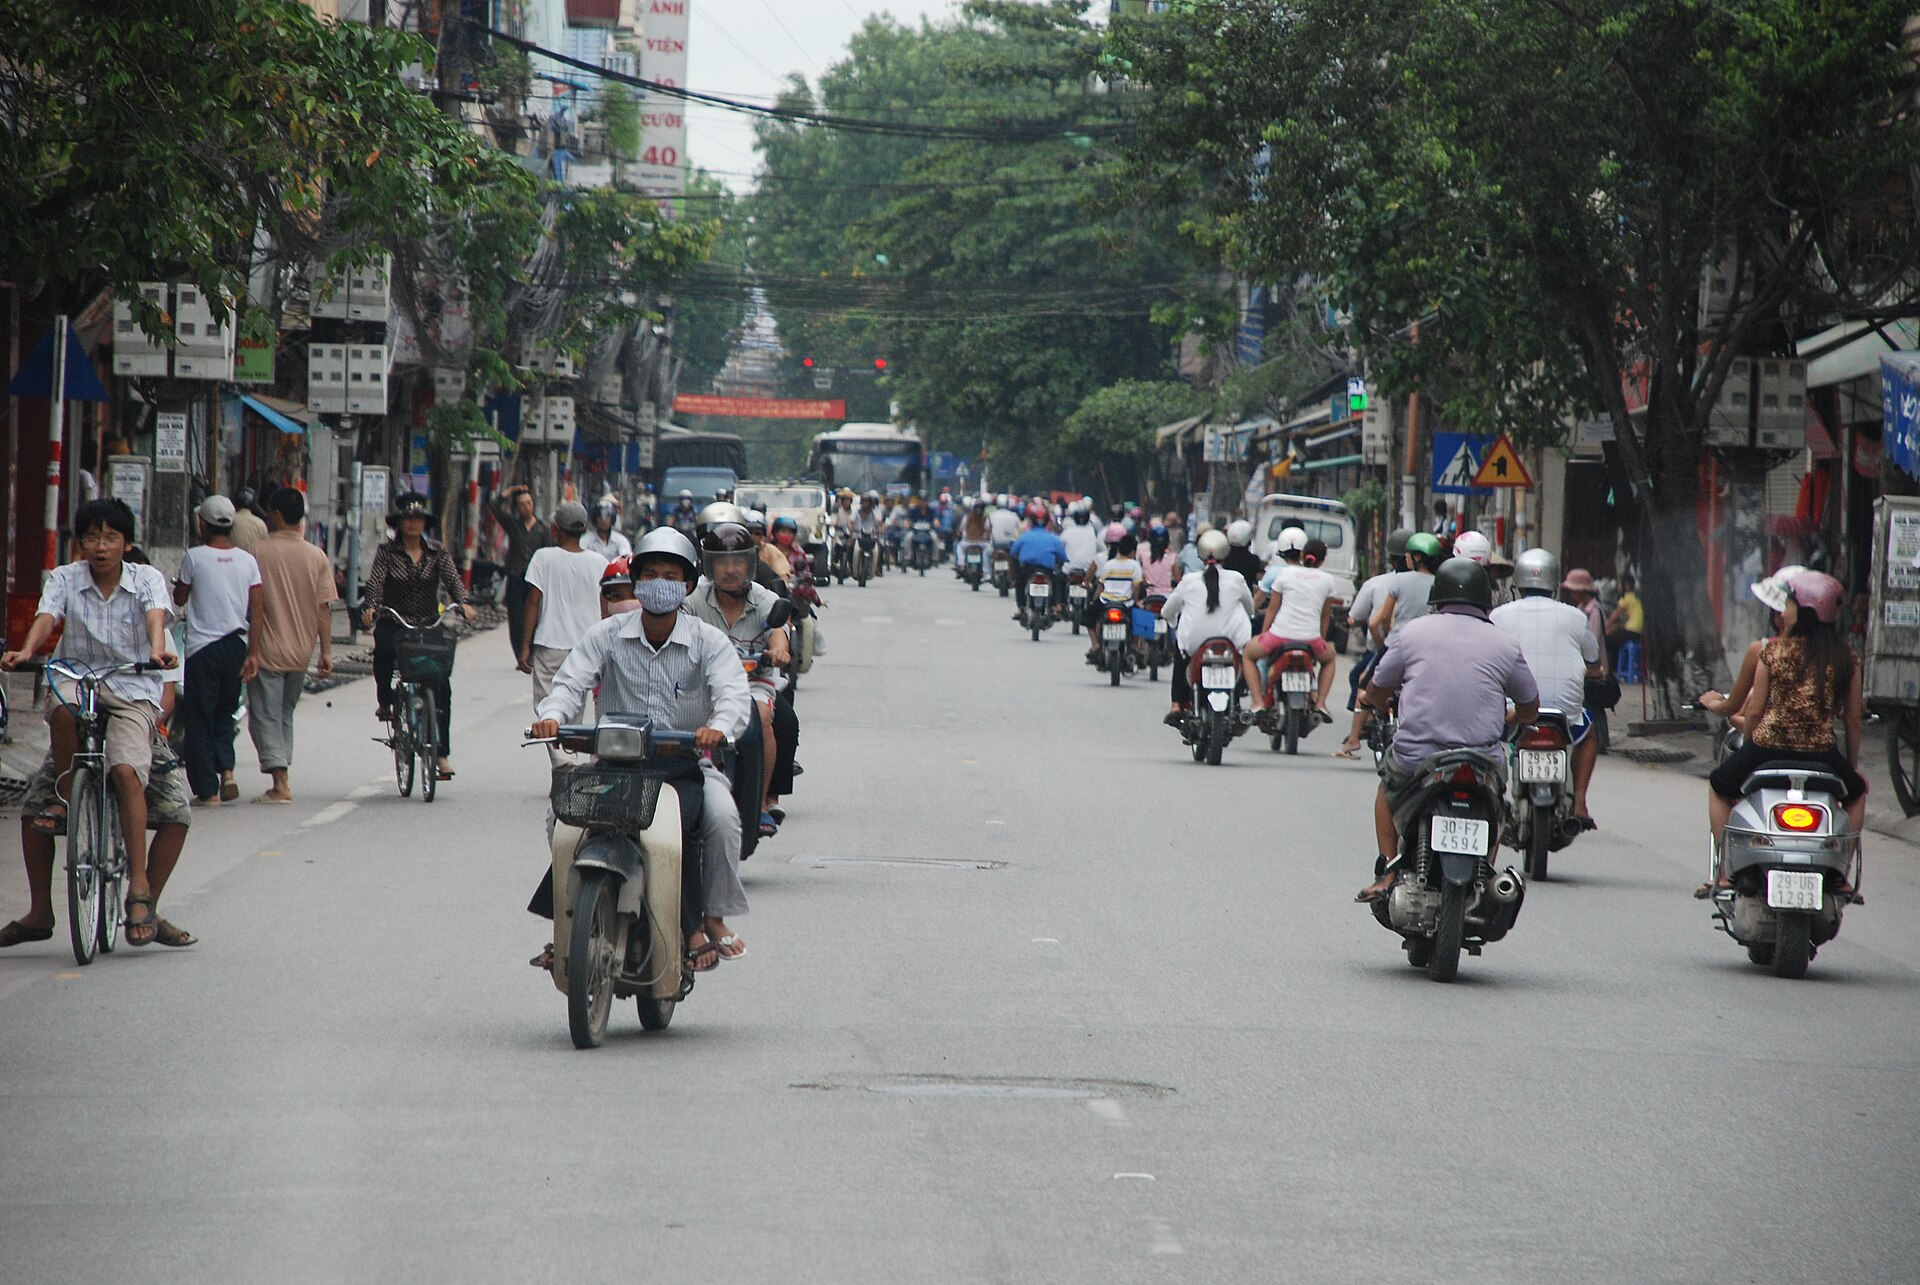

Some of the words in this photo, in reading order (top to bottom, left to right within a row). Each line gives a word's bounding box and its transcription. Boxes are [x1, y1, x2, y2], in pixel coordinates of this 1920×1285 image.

[642, 145, 677, 166] 40
[1528, 766, 1559, 780] 9292
[1440, 836, 1480, 851] 4594
[1778, 891, 1815, 906] 1293
